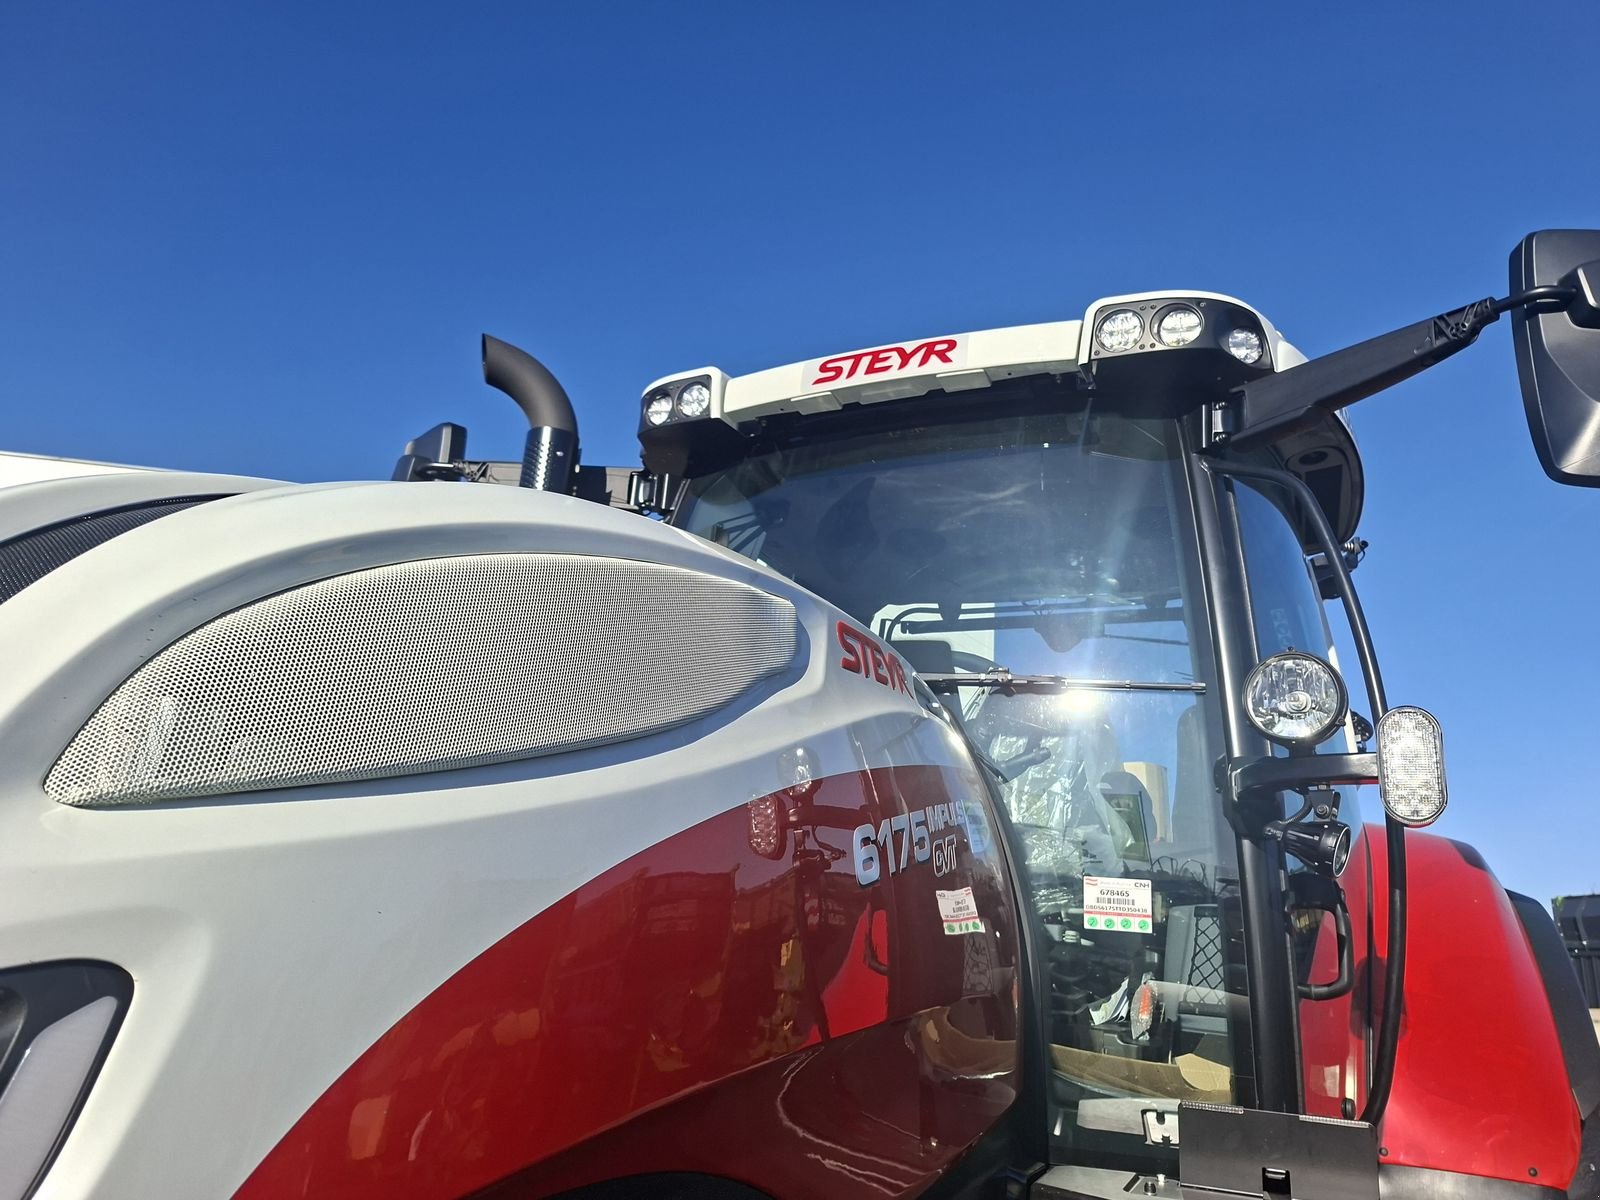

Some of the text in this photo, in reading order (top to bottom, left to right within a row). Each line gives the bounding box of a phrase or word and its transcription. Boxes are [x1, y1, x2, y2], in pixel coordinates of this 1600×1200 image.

[811, 339, 958, 386] STEYR
[836, 619, 915, 700] STEYR
[852, 809, 931, 887] 6175
[932, 834, 957, 878] CVT
[1134, 881, 1150, 889] CNH
